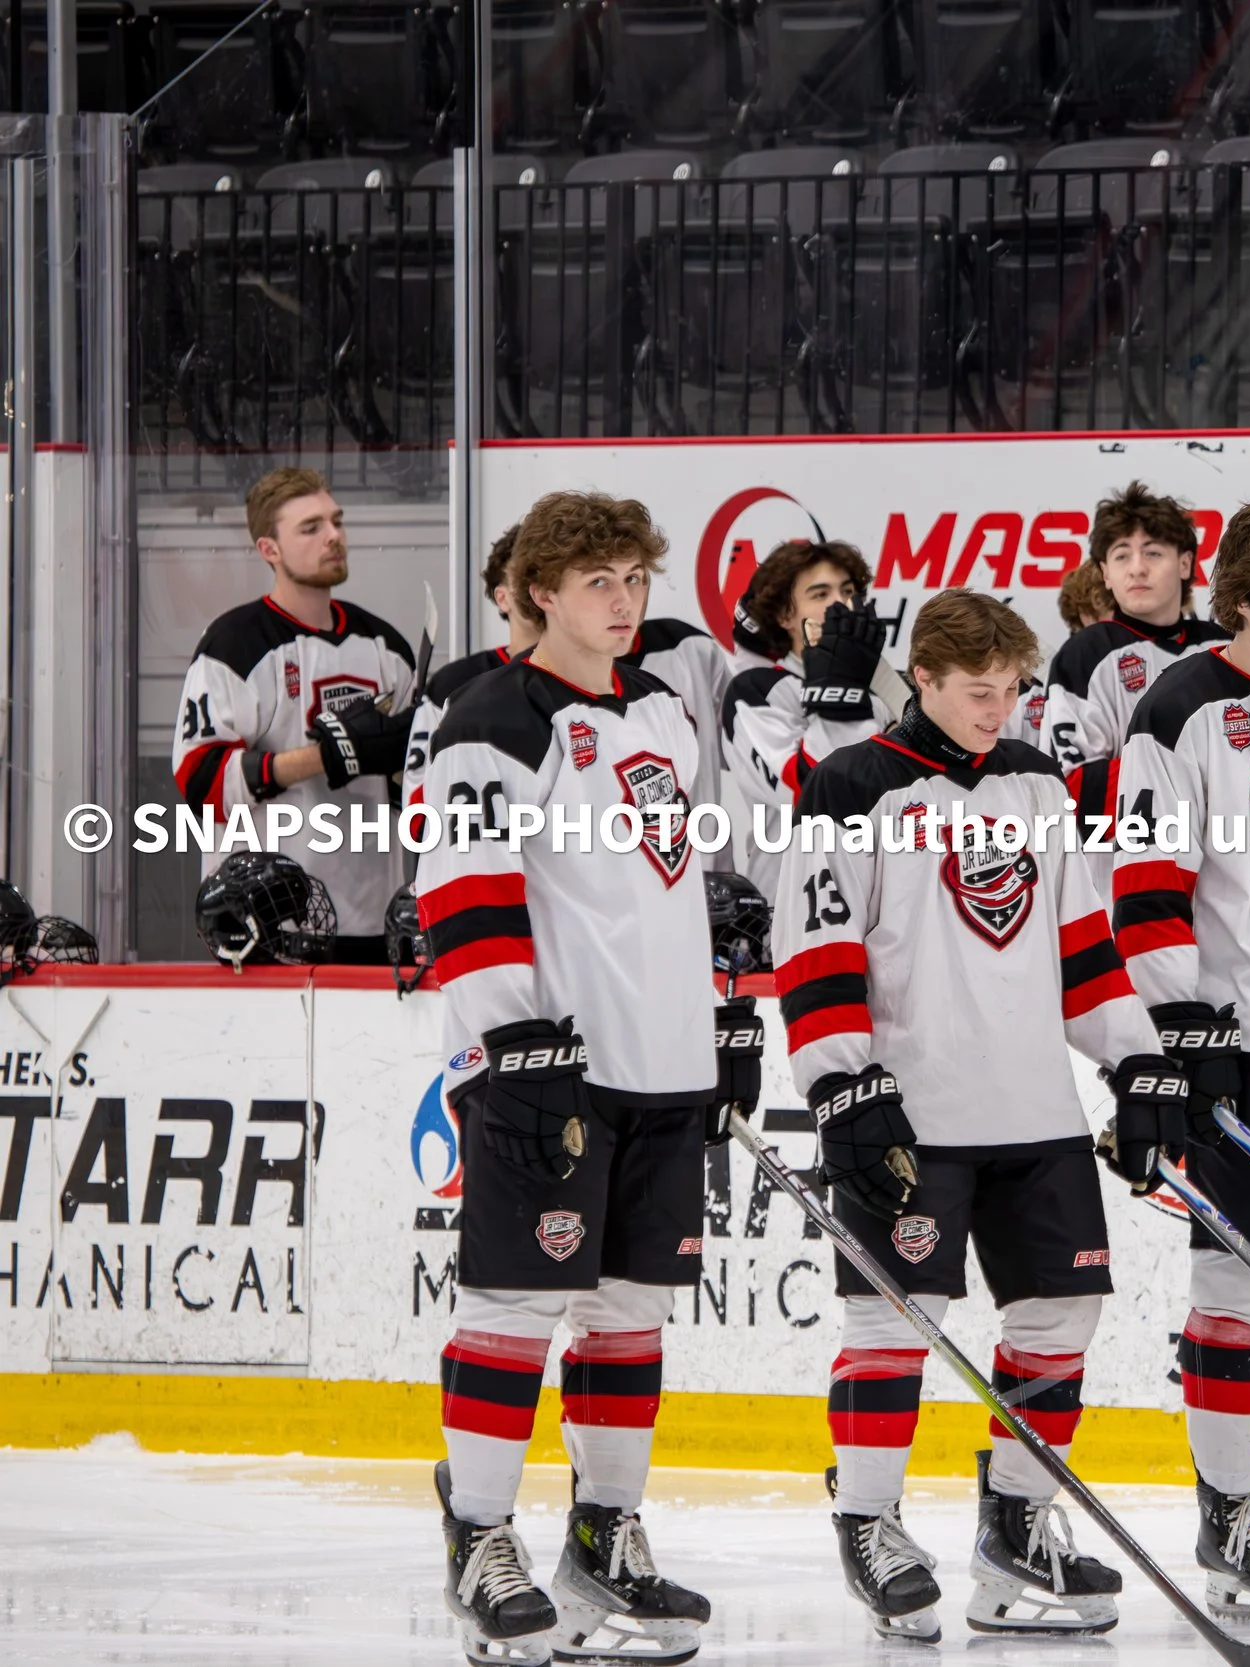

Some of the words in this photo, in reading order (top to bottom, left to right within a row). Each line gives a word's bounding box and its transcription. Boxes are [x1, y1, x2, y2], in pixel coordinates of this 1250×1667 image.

[1223, 720, 1250, 733] USPHL
[804, 868, 852, 934] 13
[816, 1077, 901, 1126] BAUE
